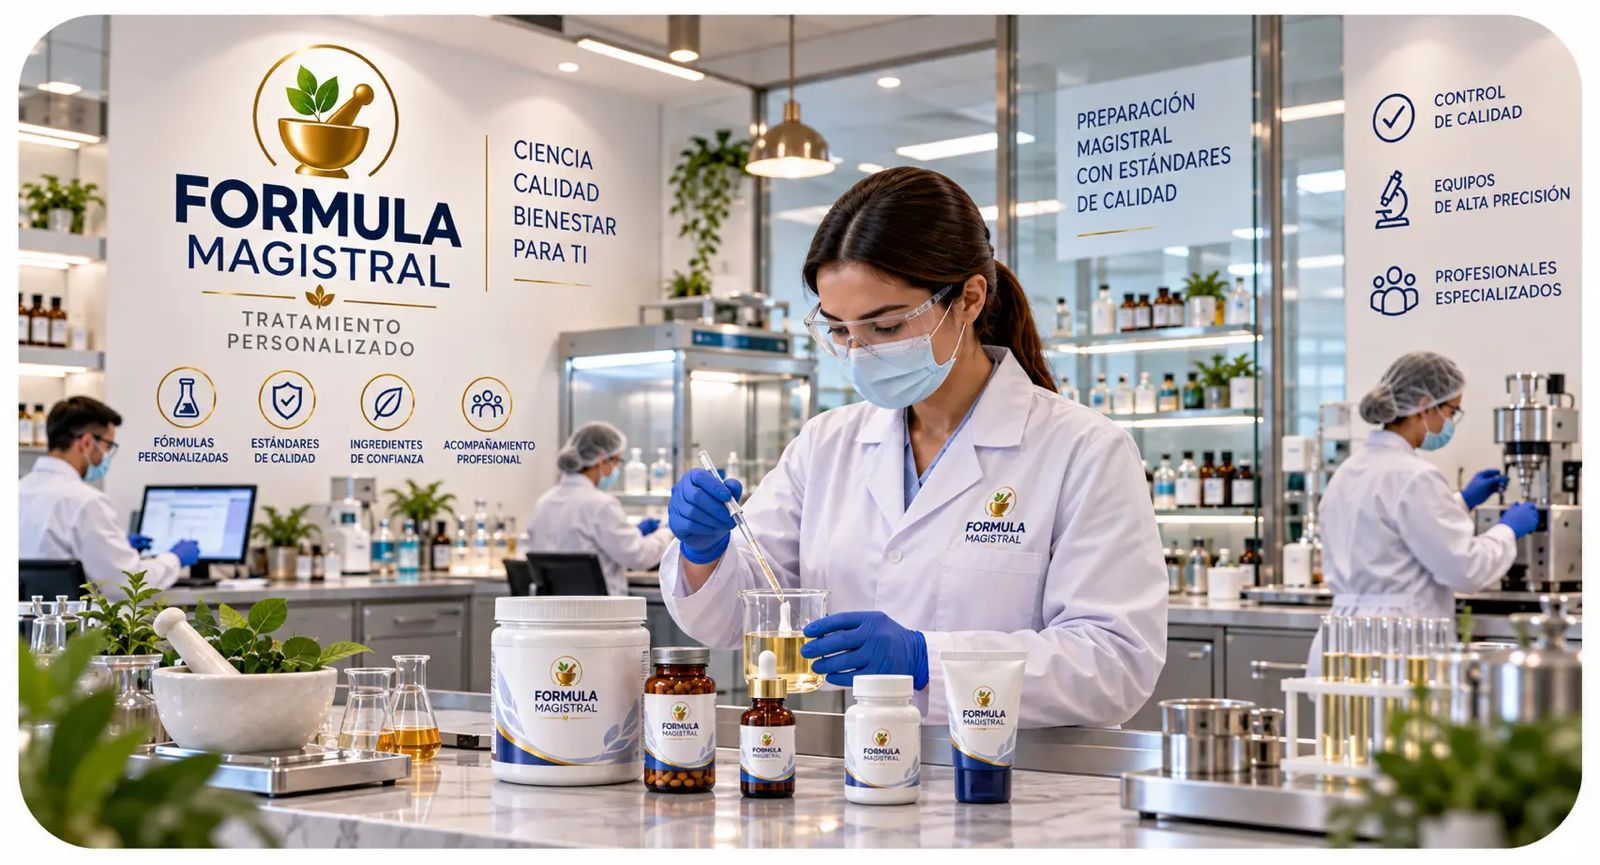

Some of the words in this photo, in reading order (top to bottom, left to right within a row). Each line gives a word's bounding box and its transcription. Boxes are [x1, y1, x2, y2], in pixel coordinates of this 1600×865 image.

[1434, 85, 1506, 107] CONTROL
[1077, 90, 1195, 130] PREPARACIÓN
[1434, 113, 1453, 129] DE
[1457, 105, 1523, 126] CALIDAD
[1077, 126, 1173, 158] MAGISTRAL
[514, 139, 594, 170] CIENCIA
[1076, 163, 1113, 185] CON
[1119, 145, 1231, 180] ESTÁNDARES
[513, 172, 600, 202] CALIDAD
[1434, 173, 1496, 193] EQUIPOS
[1077, 193, 1098, 213] DE
[1103, 183, 1177, 210] CALIDAD
[1434, 199, 1452, 214] DE
[1455, 195, 1489, 212] ALTA
[1493, 184, 1571, 208] PRECISIÓN
[175, 173, 462, 248] FORMULA
[514, 205, 617, 236] BIENESTAR
[188, 234, 450, 289] MAGISTRAL
[514, 238, 566, 263] PARA
[570, 244, 587, 264] TI
[1435, 260, 1557, 284] PROFESIONALES
[1435, 282, 1562, 305] ESPECIALIZADOS
[241, 310, 401, 335] TRATAMIENTO
[227, 332, 415, 357] PERSONALIZADO
[153, 434, 215, 448] FÓRMULAS
[251, 435, 320, 449] ESTÁNDARES
[350, 439, 423, 450] INGREDIENTES
[443, 438, 536, 451] ACOMPAÑAMIENTO
[138, 451, 229, 463] PERSONALIZADAS
[254, 452, 269, 464] DE
[270, 452, 316, 464] CALIDAD
[350, 453, 364, 464] DE
[366, 453, 424, 464] CONFIANZA
[457, 454, 522, 465] PROFESIONAL
[965, 521, 1026, 533] FORMULA
[964, 534, 1022, 545] MAGISTRAL
[534, 690, 599, 702] FORMULA
[534, 703, 598, 713] MAGISTRAL
[962, 709, 1006, 718] FORMULA
[662, 722, 699, 730] FORMULA
[863, 747, 901, 755] FORMULA
